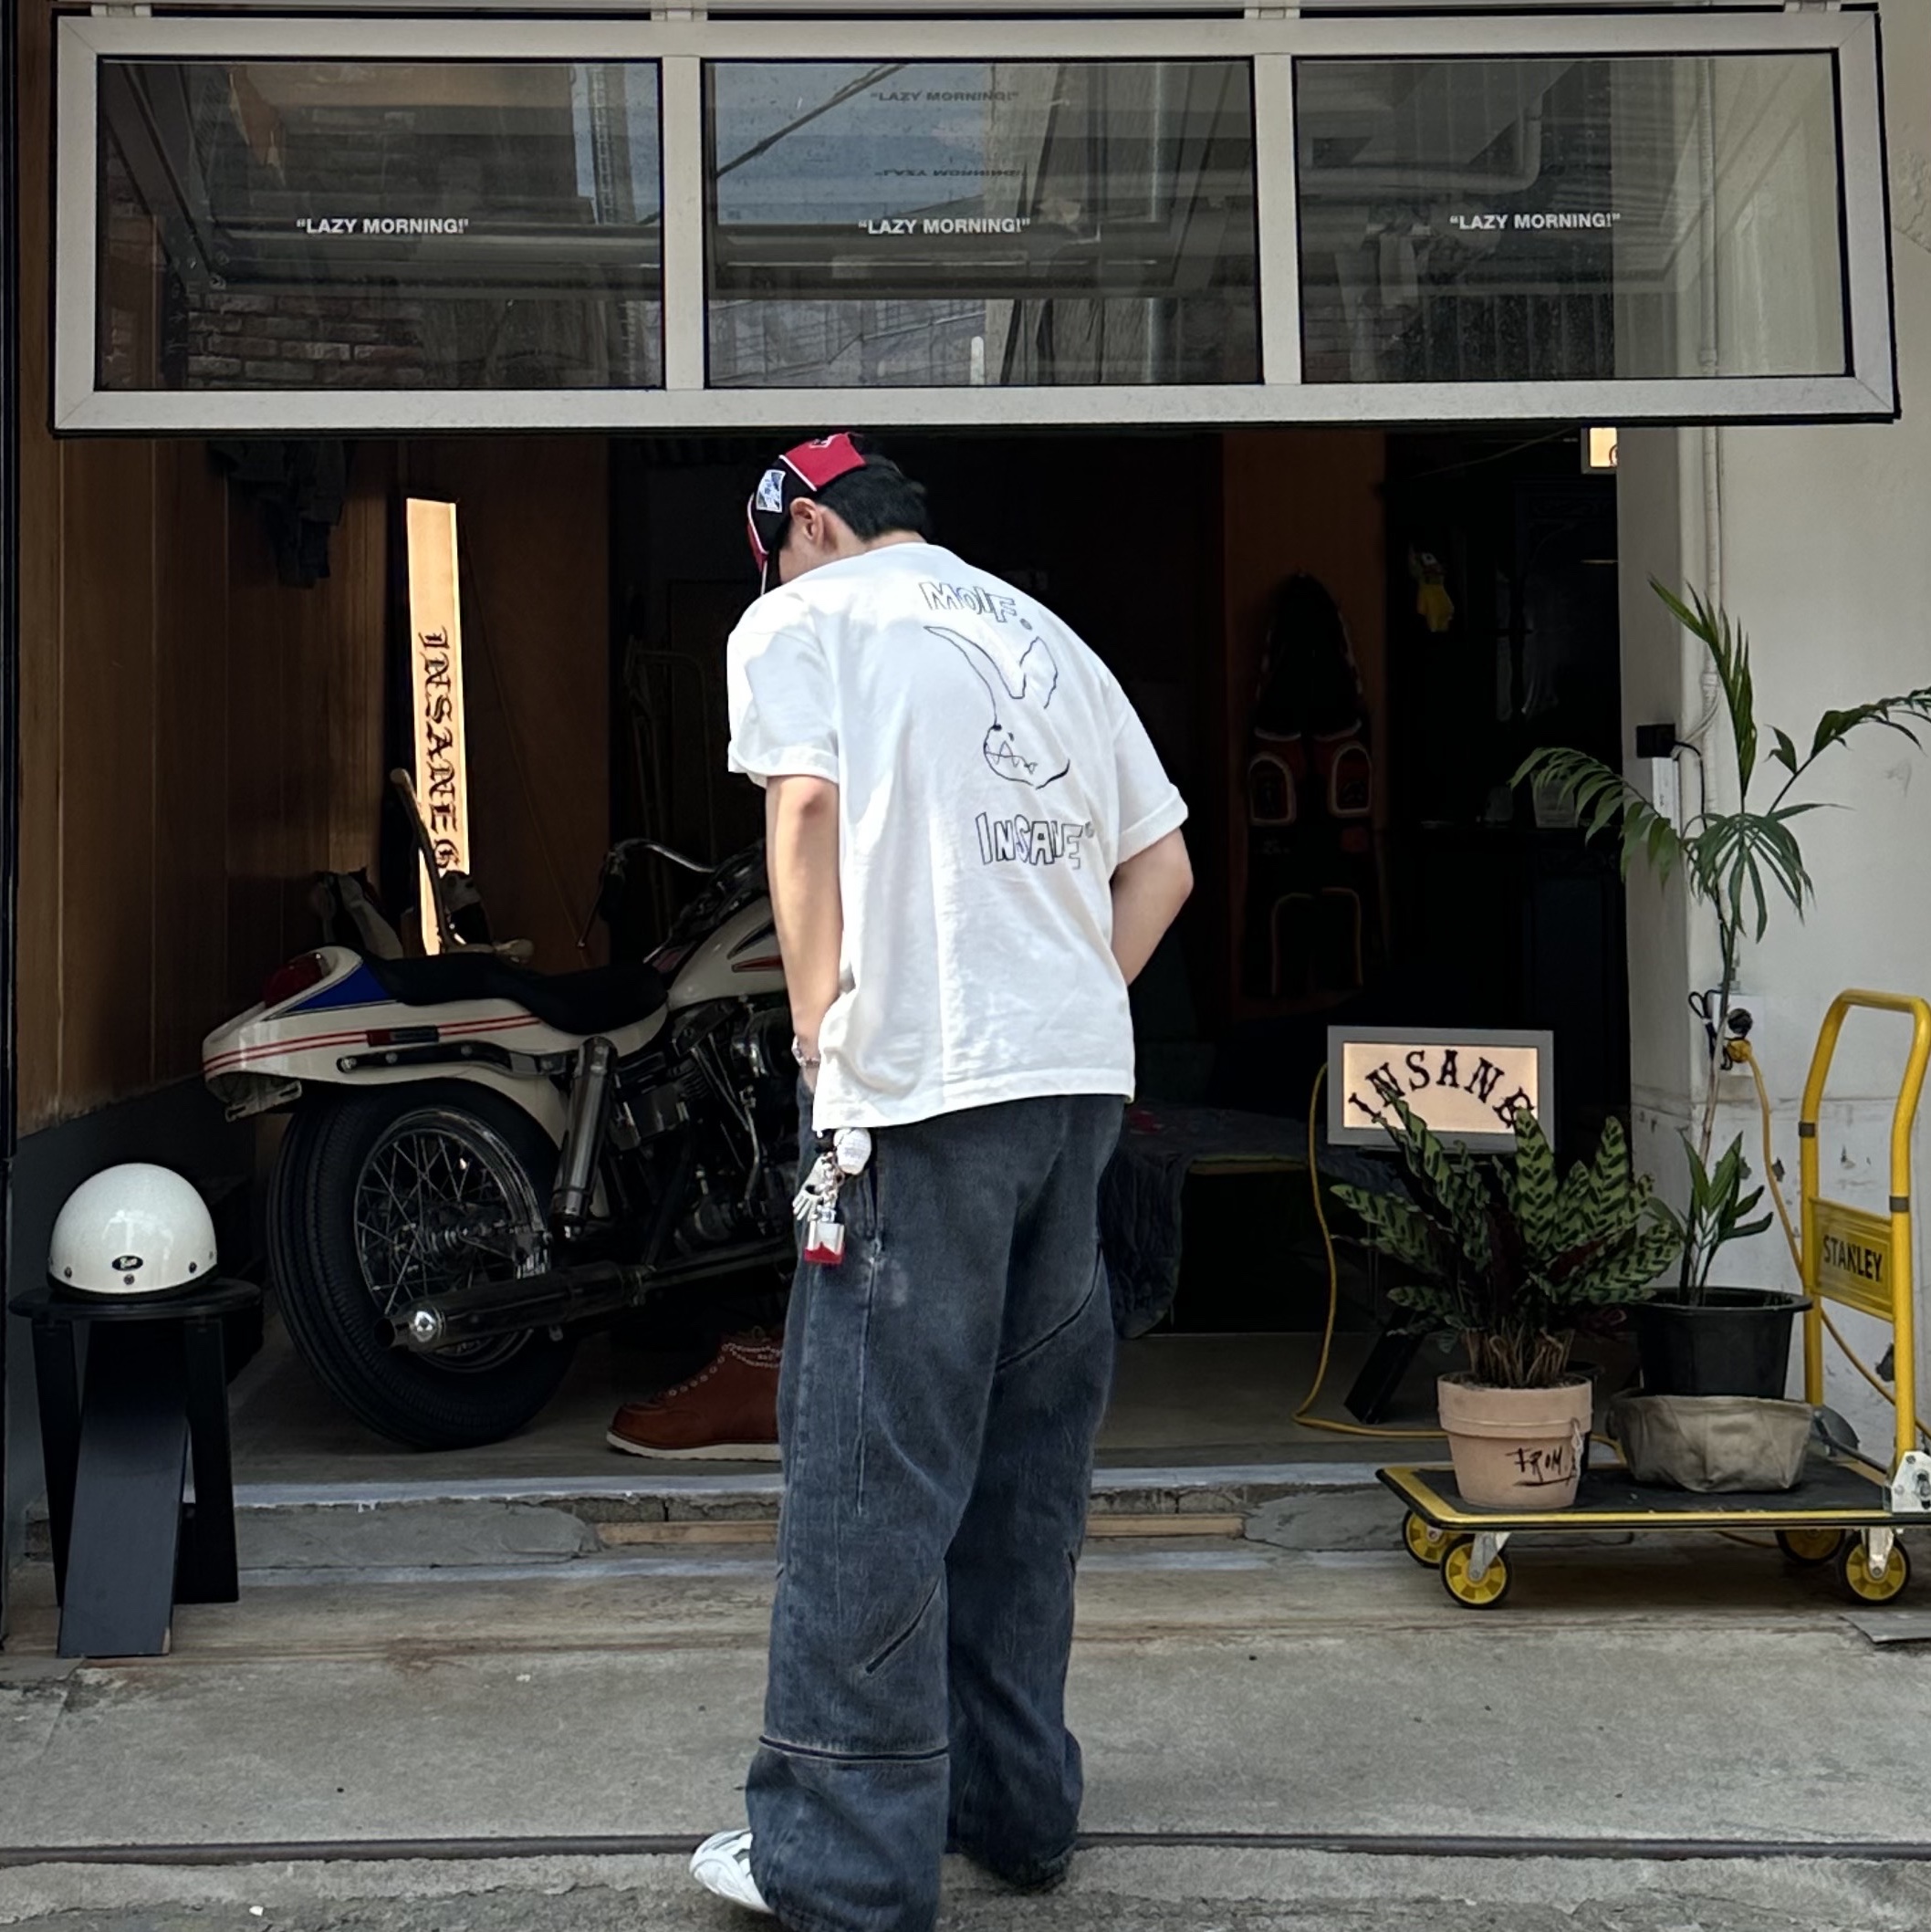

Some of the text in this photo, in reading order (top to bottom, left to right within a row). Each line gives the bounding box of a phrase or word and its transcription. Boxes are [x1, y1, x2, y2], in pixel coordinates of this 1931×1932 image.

[297, 218, 357, 234] “LAZY
[858, 218, 1030, 235] “LAZY MORNING!”
[1449, 213, 1621, 229] “LAZY MORNING!”
[1348, 1049, 1535, 1129] INSANE
[1822, 1234, 1883, 1282] STANLEY
